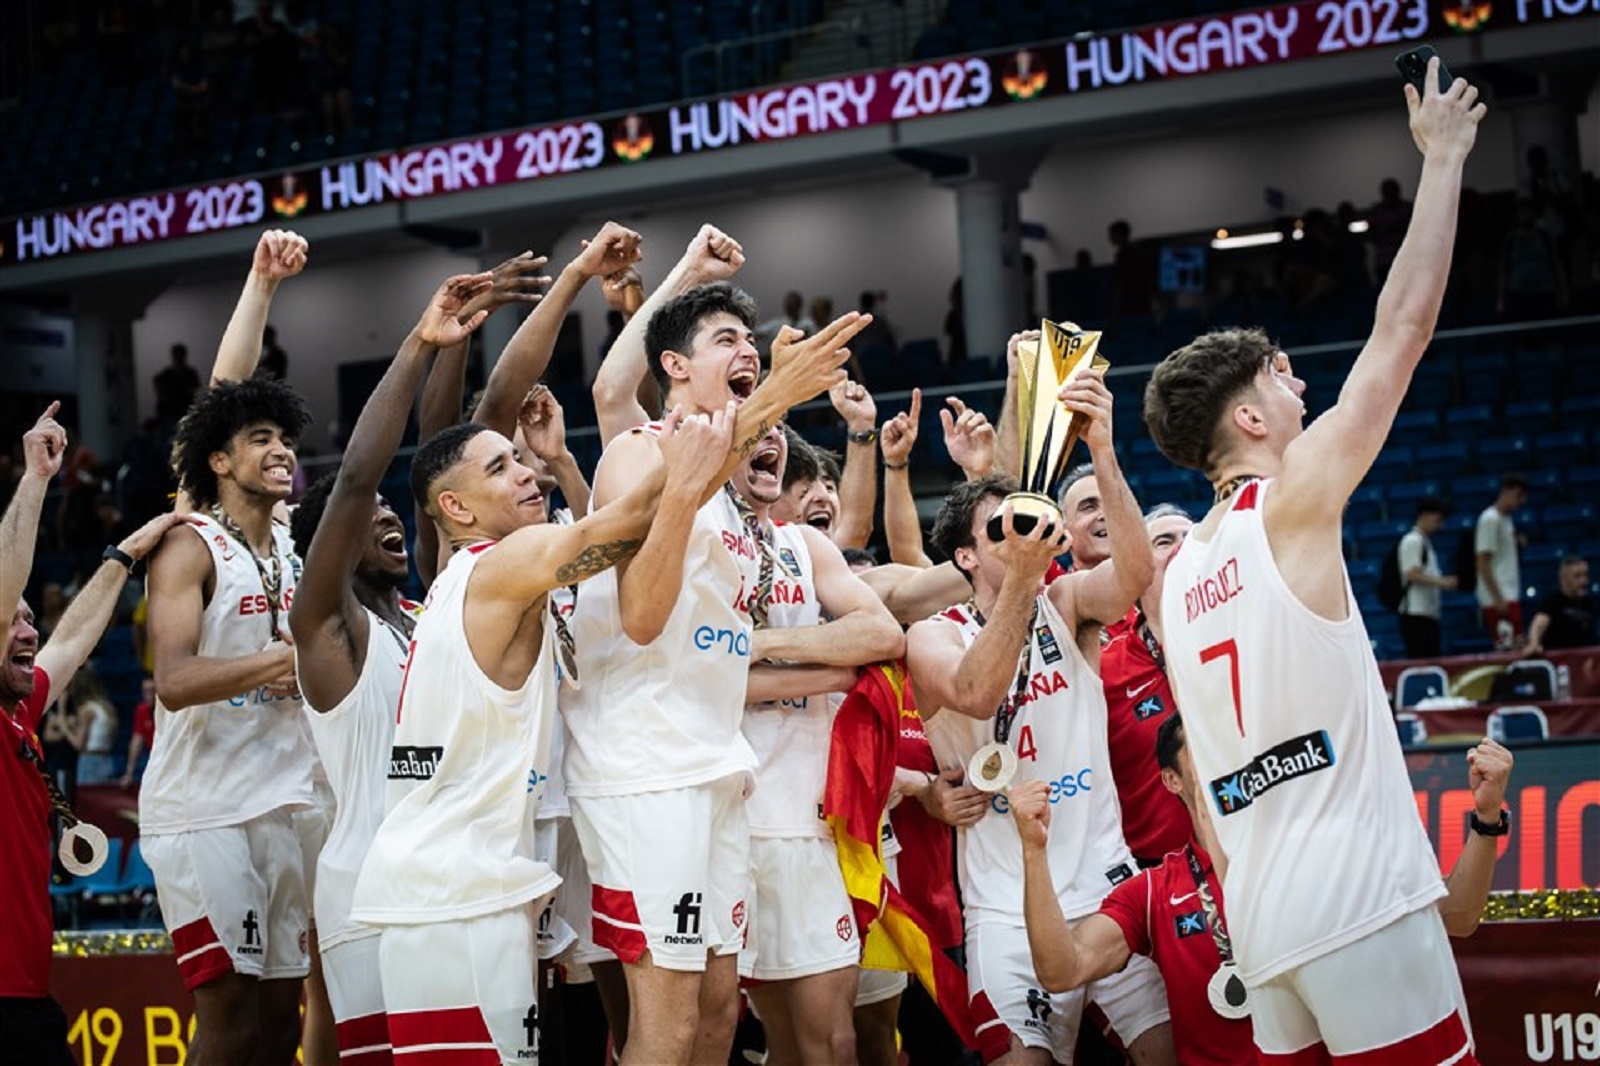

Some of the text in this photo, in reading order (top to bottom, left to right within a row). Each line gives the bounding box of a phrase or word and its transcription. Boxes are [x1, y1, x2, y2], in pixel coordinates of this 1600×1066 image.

[1066, 0, 1429, 92] HUNGARY 2023
[669, 57, 993, 154] HUNGARY 2023
[320, 121, 605, 210] HUNGARY 2023
[16, 179, 266, 261] HUNGARY 2023
[1200, 638, 1246, 739] 7
[1017, 725, 1037, 762] 4
